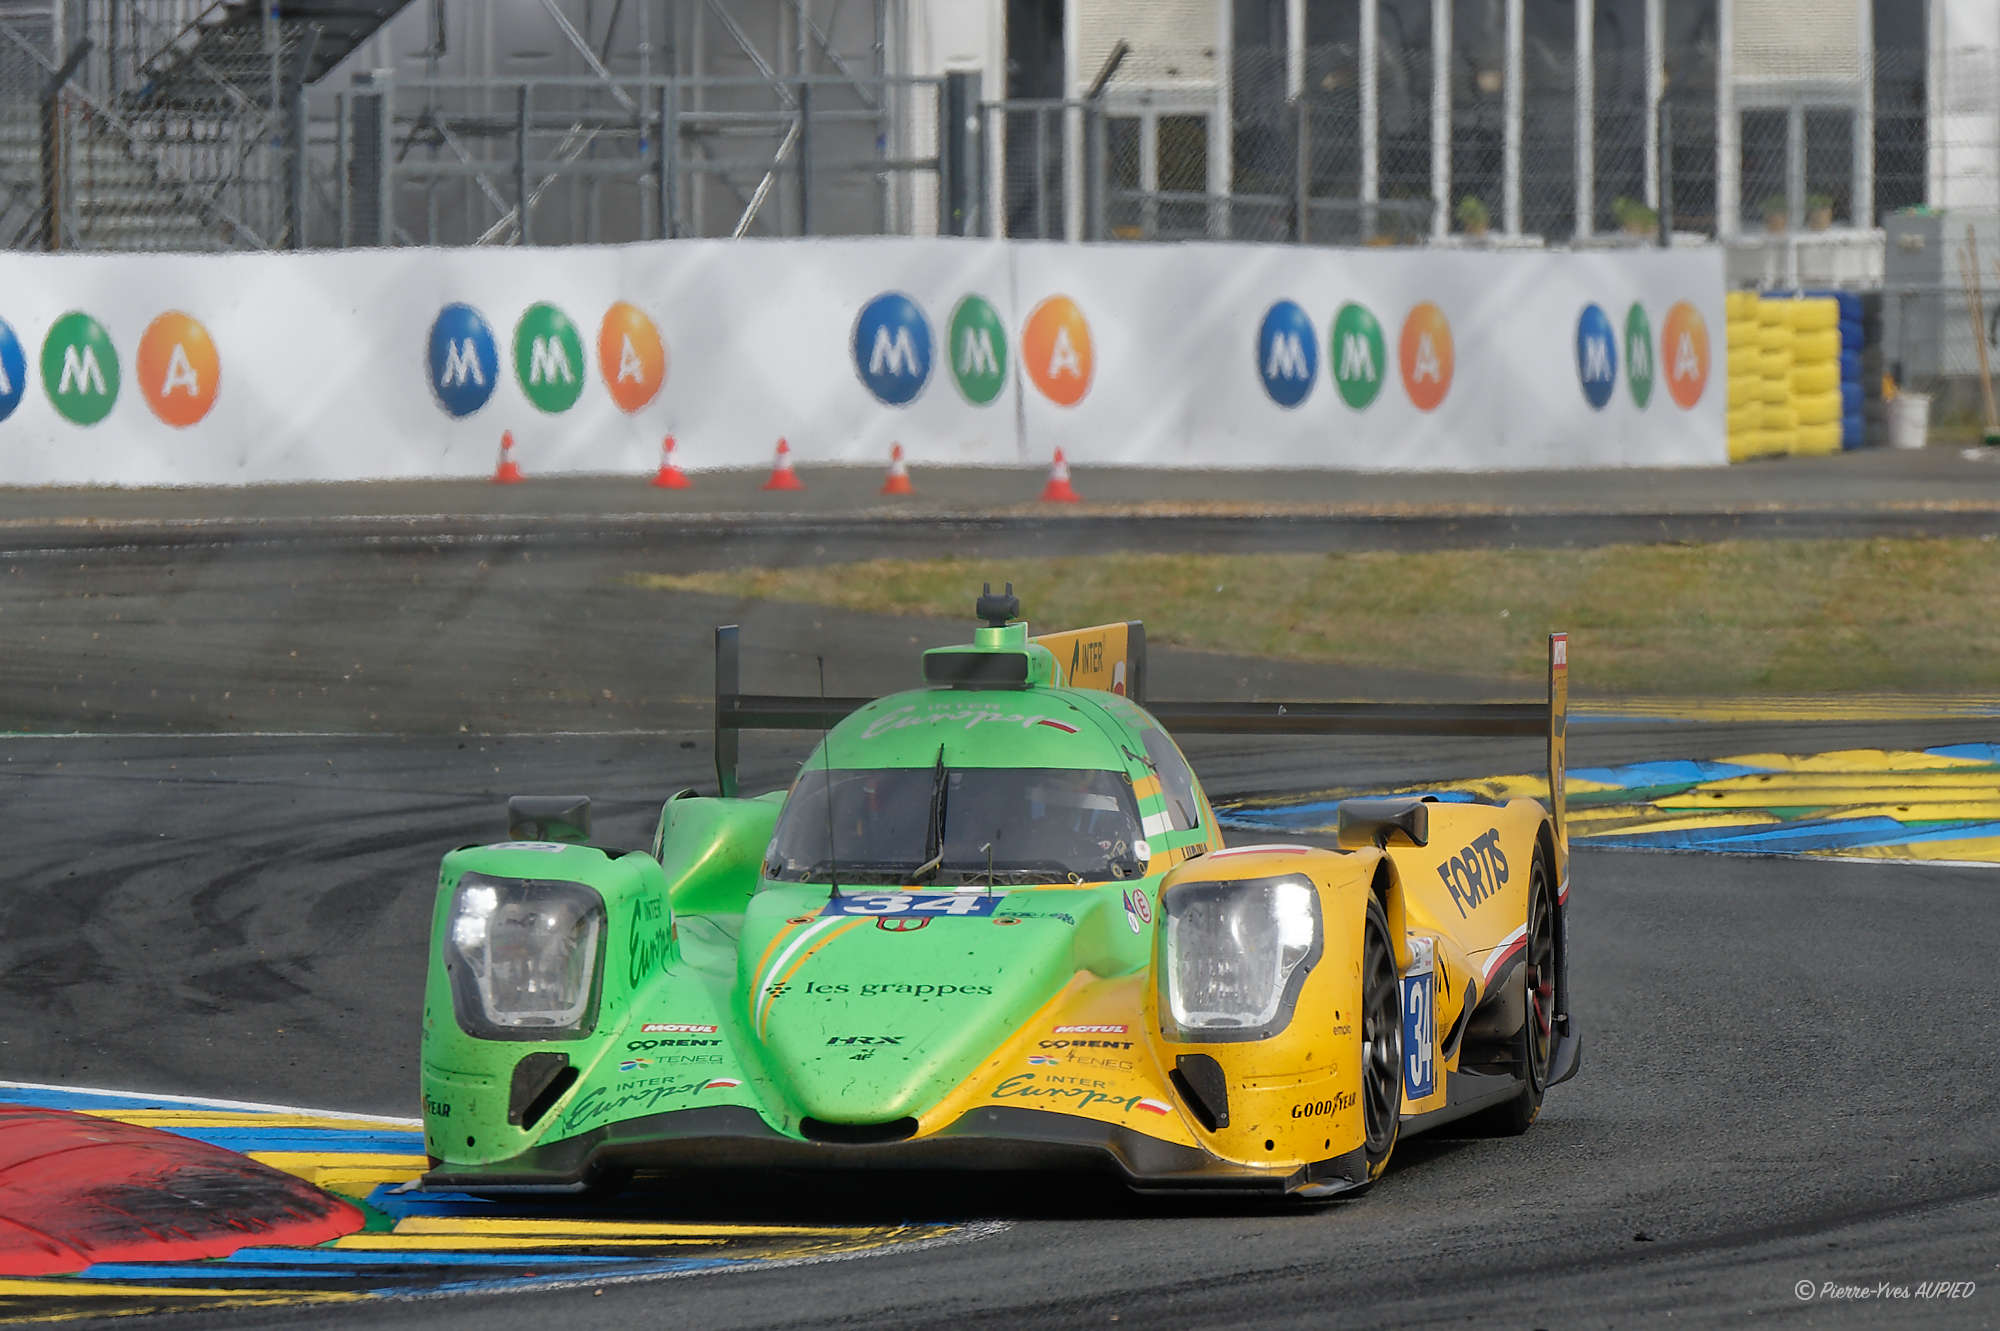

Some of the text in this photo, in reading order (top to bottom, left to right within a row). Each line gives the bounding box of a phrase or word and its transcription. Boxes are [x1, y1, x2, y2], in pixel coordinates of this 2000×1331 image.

[1082, 641, 1104, 675] INTER
[1437, 828, 1509, 919] FORTIS
[843, 895, 980, 915] 34
[805, 981, 993, 998] les grappes
[644, 1025, 717, 1033] MOTUL
[1055, 1025, 1124, 1033] MOTUL
[1410, 978, 1432, 1085] 34
[826, 1036, 905, 1045] HRX
[616, 1076, 675, 1092] INTER
[1046, 1075, 1105, 1089] INTER
[992, 1073, 1143, 1112] Europol
[565, 1078, 712, 1130] Europol
